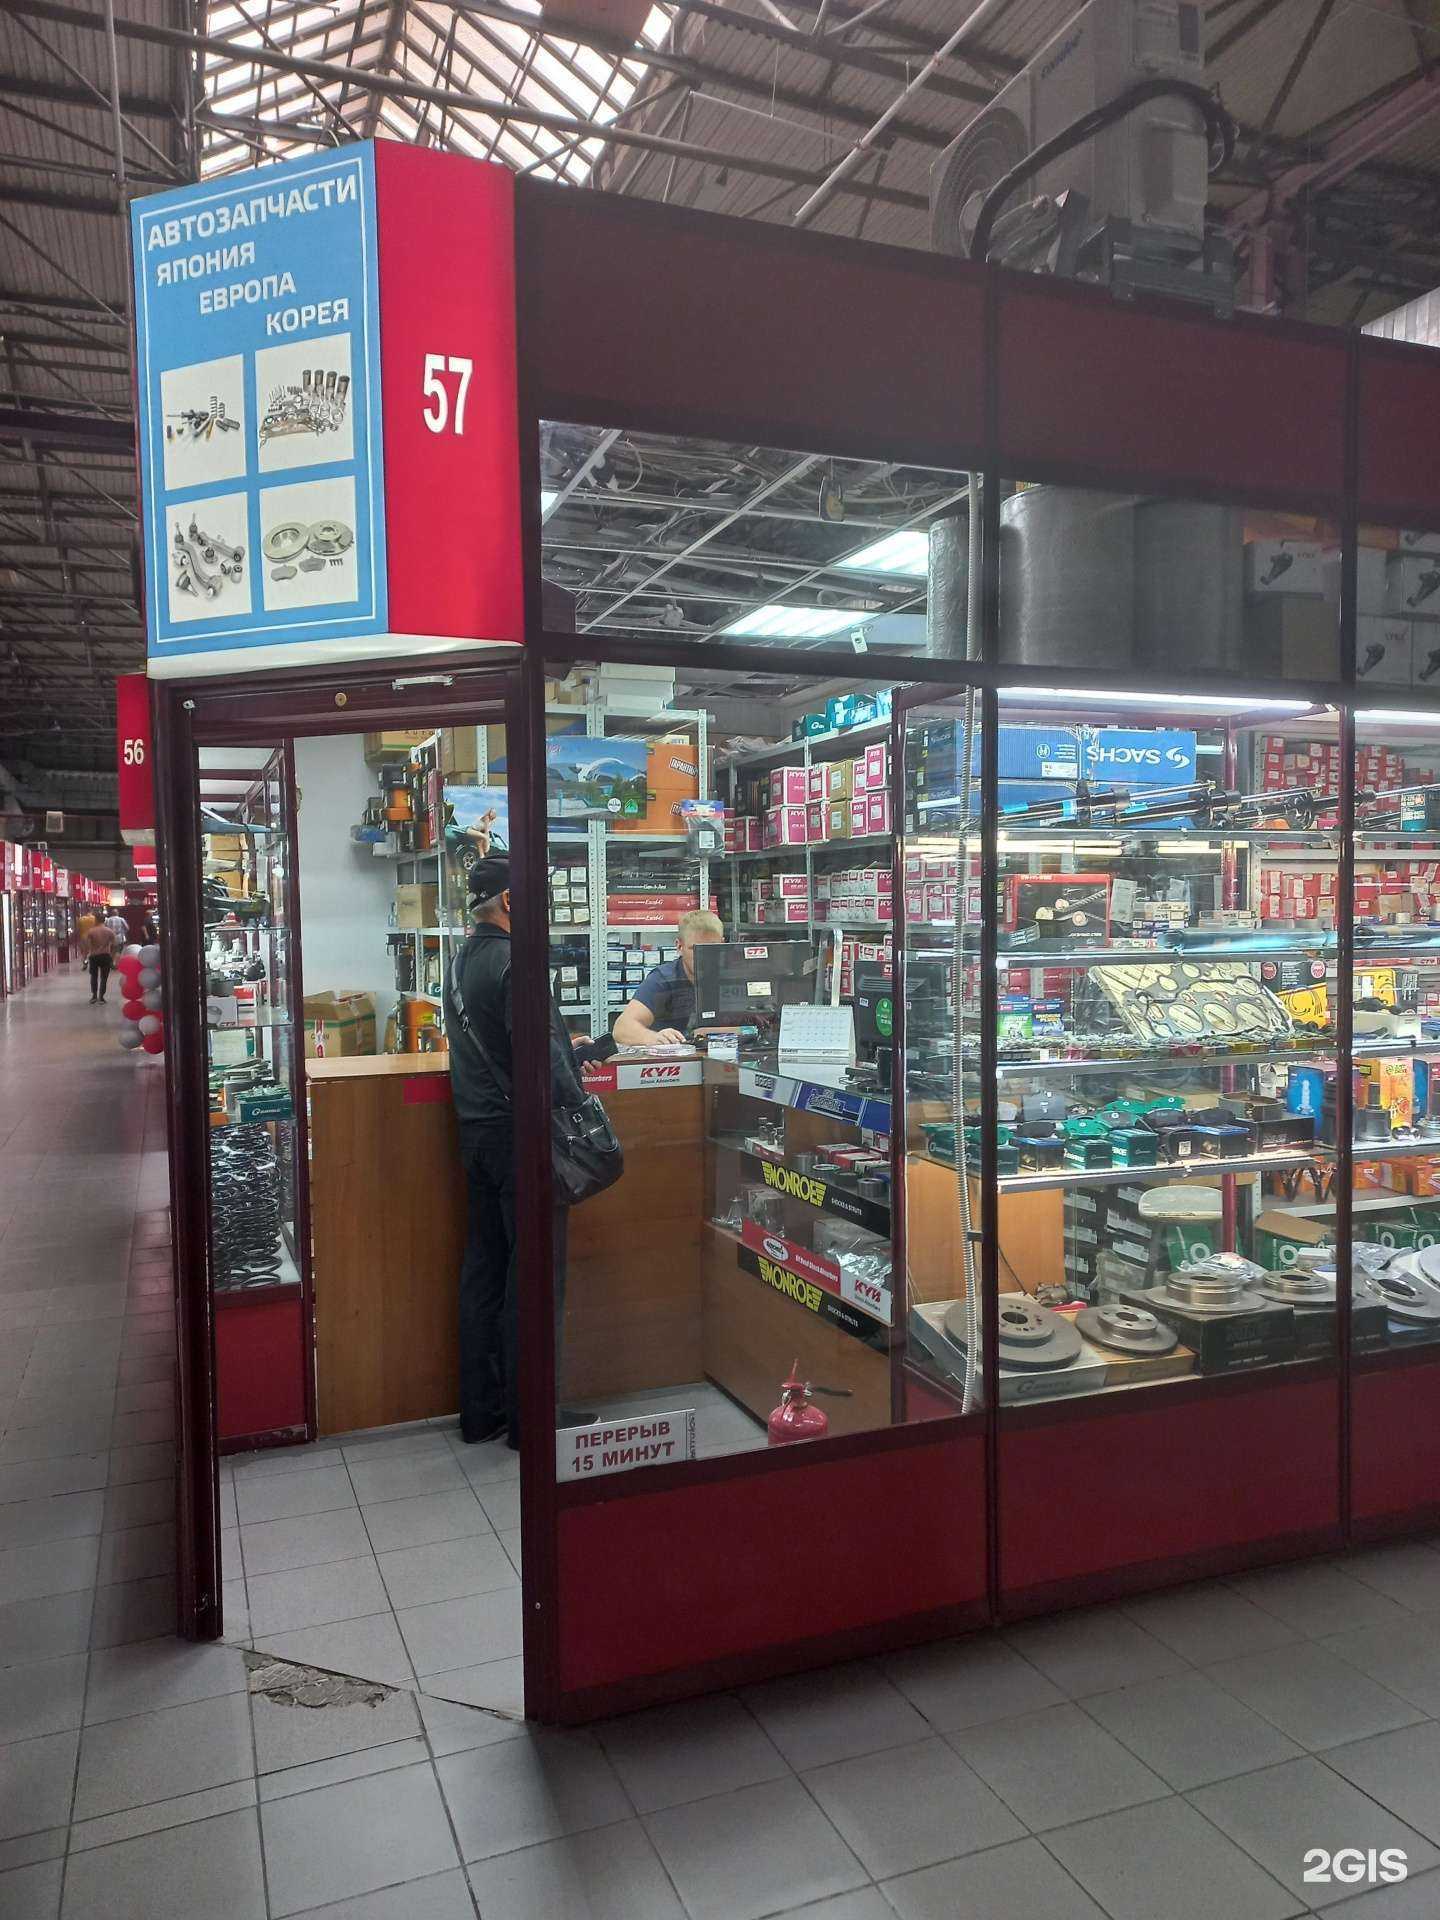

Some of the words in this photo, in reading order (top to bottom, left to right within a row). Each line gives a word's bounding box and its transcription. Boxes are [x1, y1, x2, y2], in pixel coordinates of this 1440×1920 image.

[148, 173, 357, 251] АВТОЗАПЧАСТИ
[157, 241, 256, 287] ЯПОНИЯ
[199, 271, 296, 315] ЕВРОПА
[265, 298, 350, 336] КОРЕЯ
[423, 353, 473, 435] 57
[123, 738, 145, 766] 56
[1087, 745, 1161, 765] SACHS
[640, 1066, 681, 1078] KYB
[762, 1161, 826, 1206] MONROE
[760, 1257, 821, 1311] MONROE
[855, 1280, 881, 1302] KYB
[575, 1421, 671, 1450] ПЕРЕРЫВ
[571, 1455, 595, 1473] 15
[602, 1440, 676, 1468] МИНУТ
